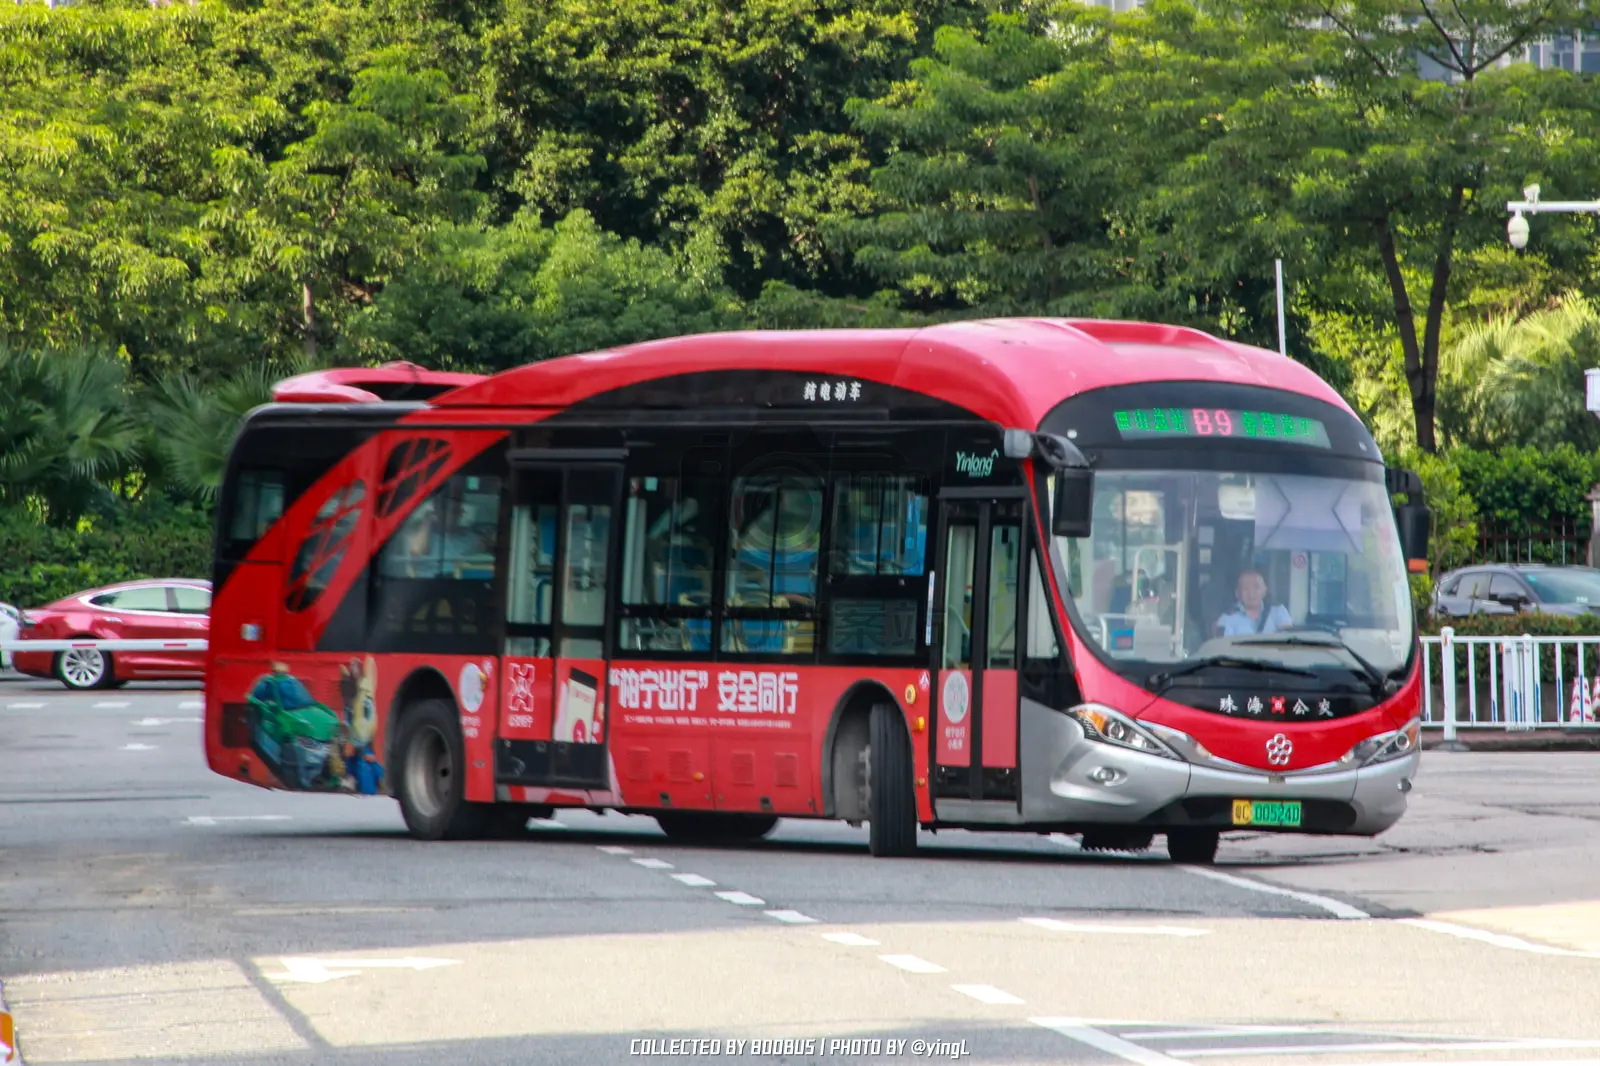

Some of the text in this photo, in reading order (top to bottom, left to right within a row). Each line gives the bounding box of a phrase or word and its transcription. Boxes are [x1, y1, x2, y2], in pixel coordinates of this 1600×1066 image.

[1192, 408, 1233, 436] B9
[955, 450, 996, 477] Yinlong
[717, 670, 799, 715] 安全同行
